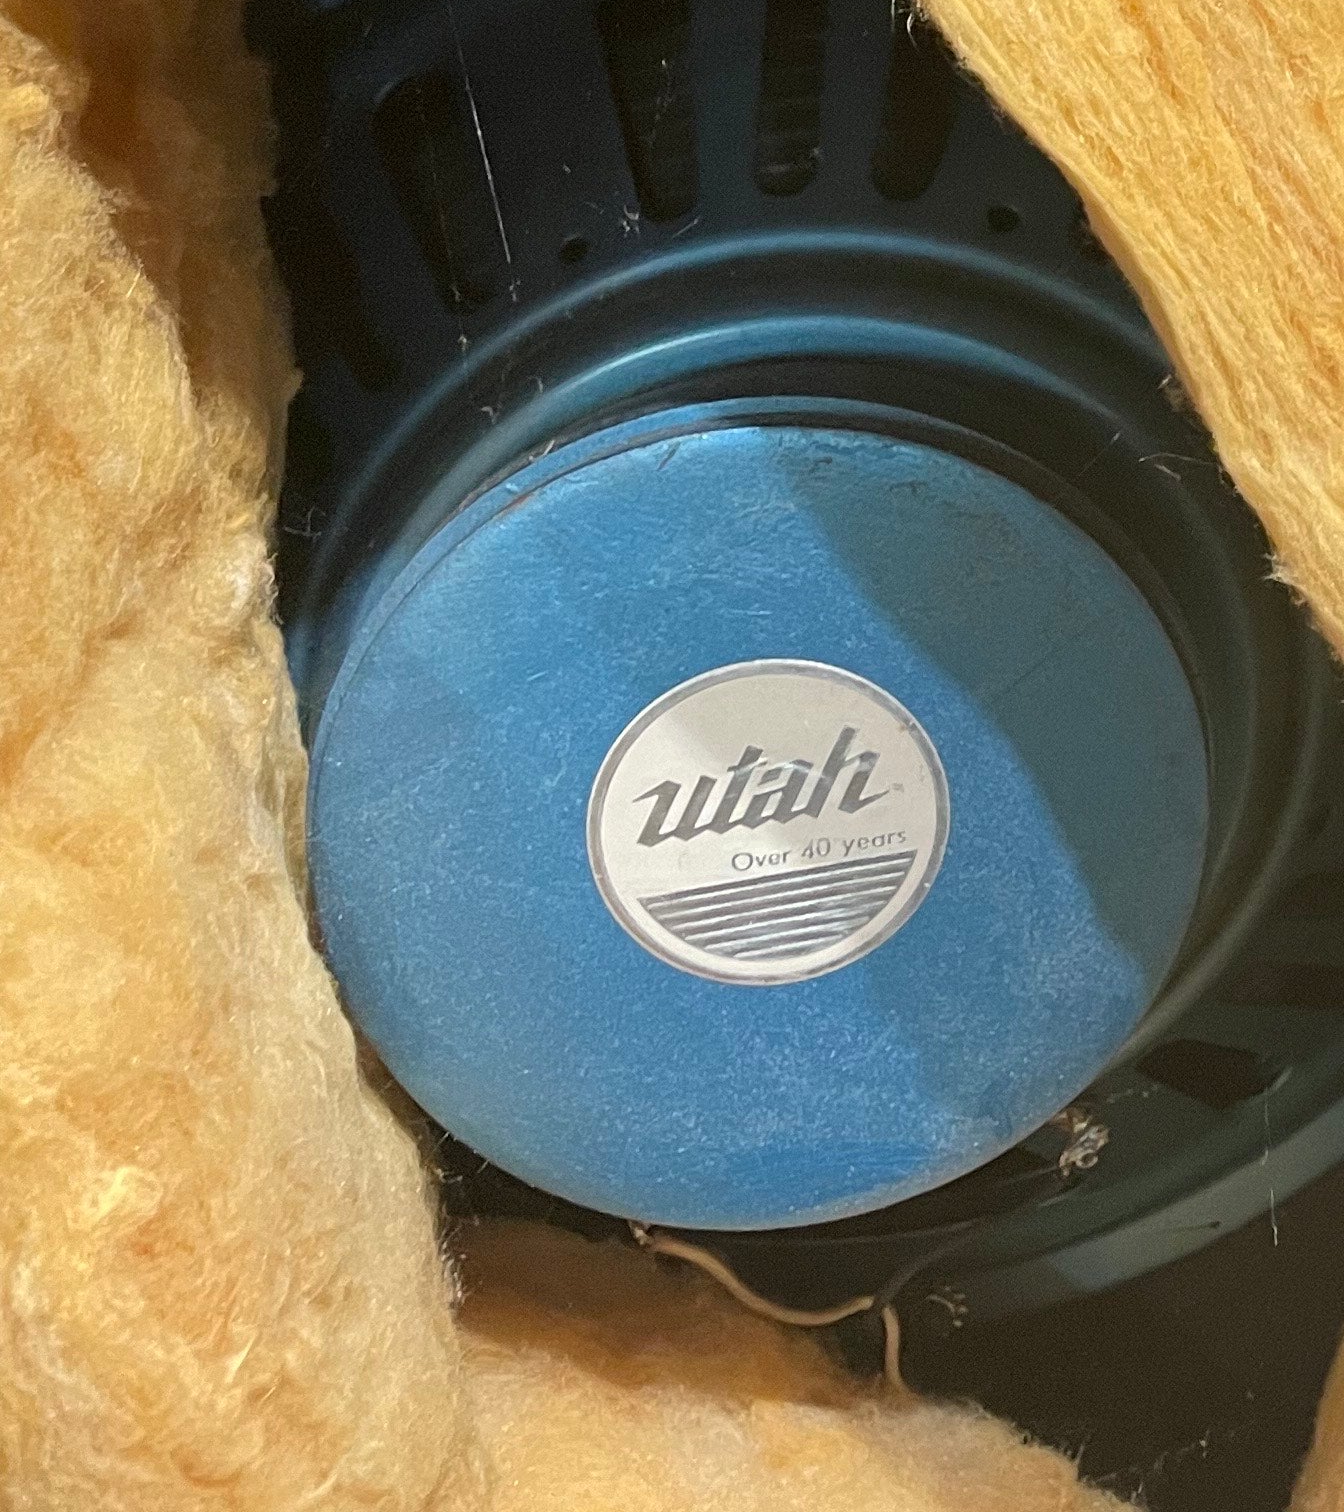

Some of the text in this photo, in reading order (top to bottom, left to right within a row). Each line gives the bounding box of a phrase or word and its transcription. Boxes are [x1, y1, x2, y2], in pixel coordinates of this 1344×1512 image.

[632, 724, 890, 849] utah
[731, 830, 906, 872] Over 40 years
